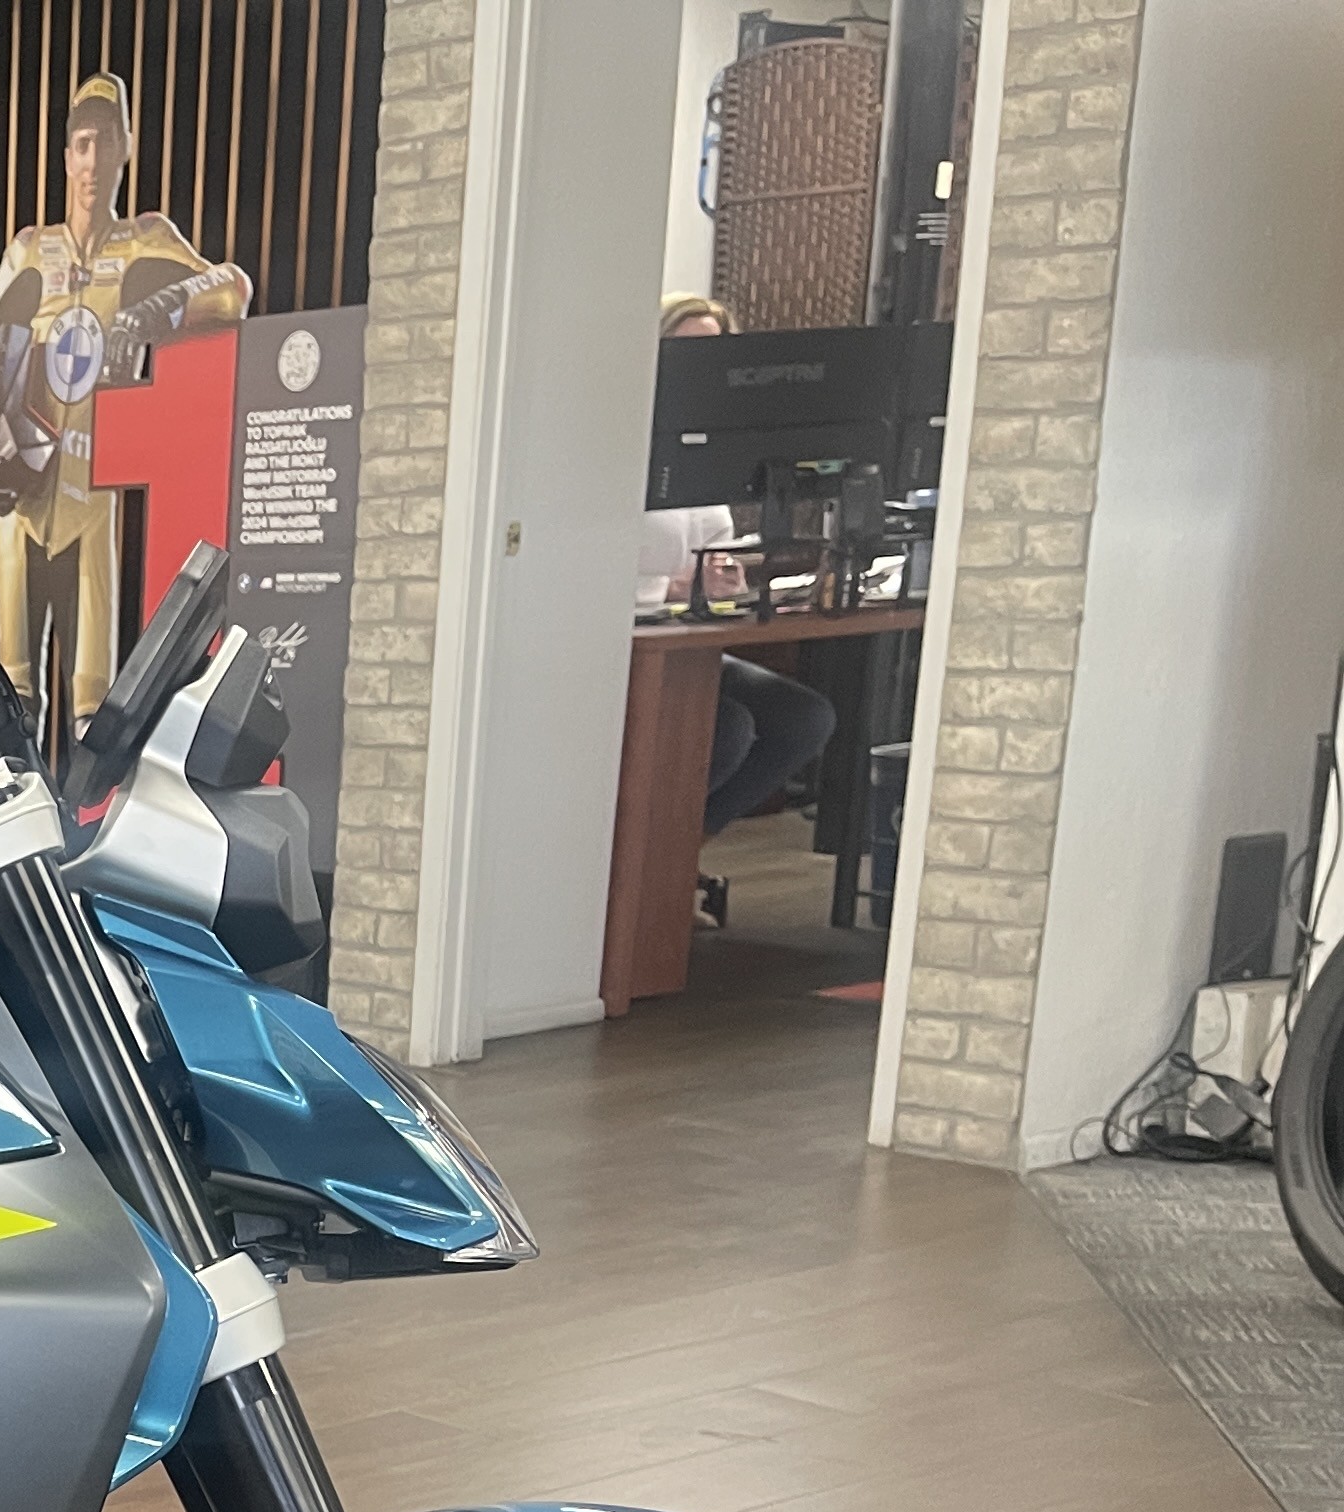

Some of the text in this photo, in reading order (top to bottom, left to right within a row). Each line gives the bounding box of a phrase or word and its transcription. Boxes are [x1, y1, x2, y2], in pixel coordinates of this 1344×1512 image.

[246, 404, 353, 425] CONGRATULATIONS
[246, 426, 262, 440] TO
[242, 500, 264, 515] FOR
[315, 498, 338, 512] THE
